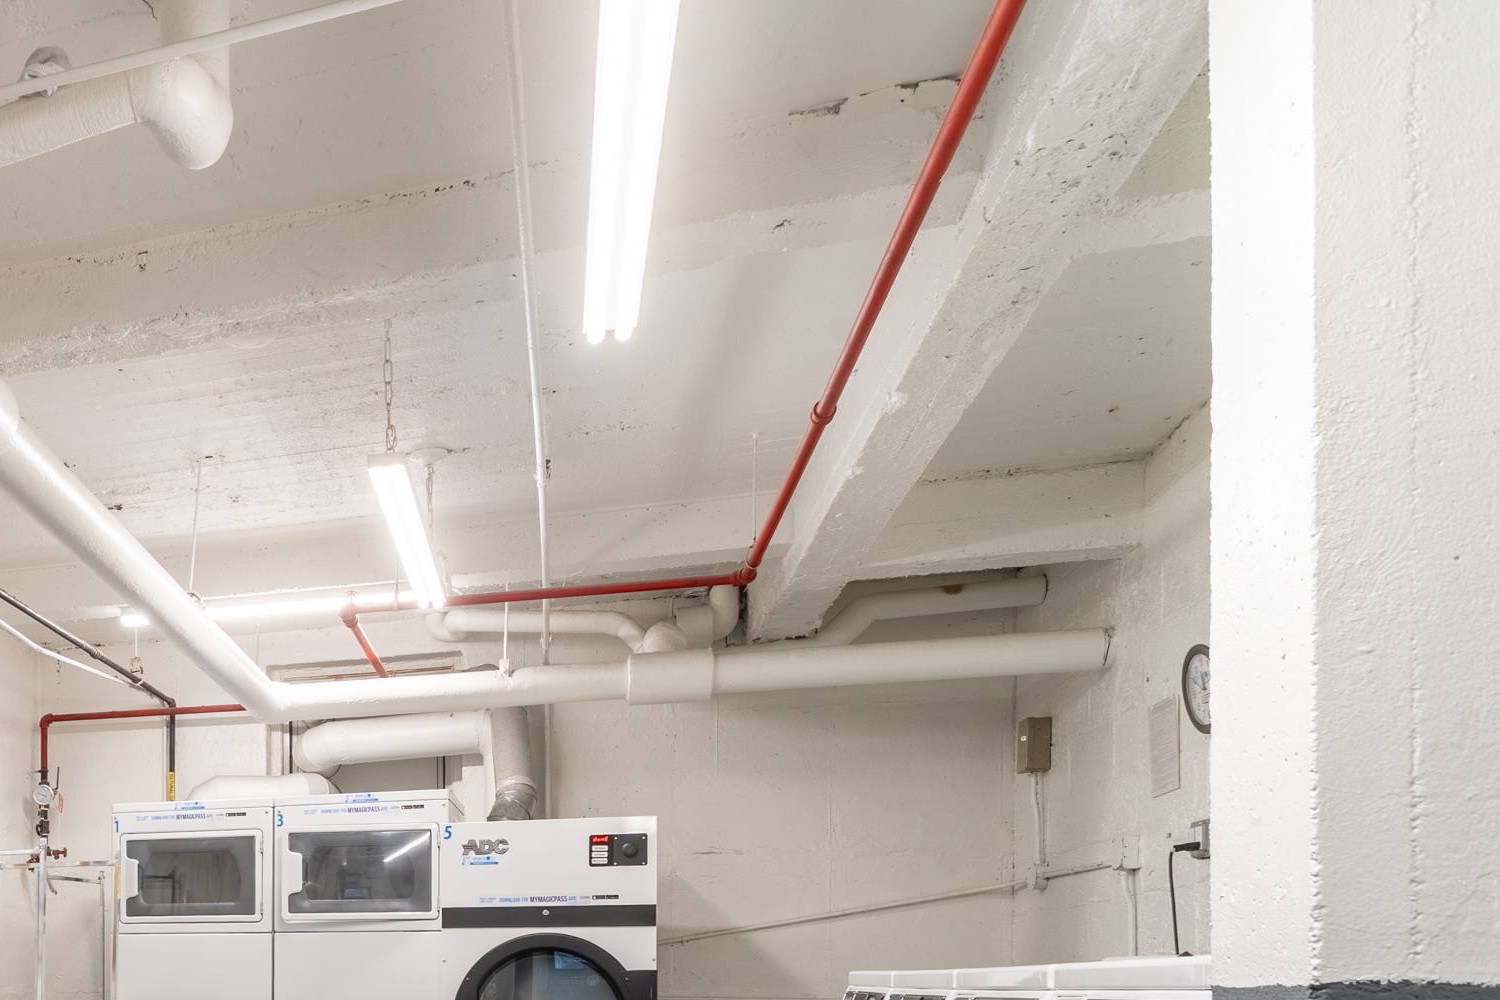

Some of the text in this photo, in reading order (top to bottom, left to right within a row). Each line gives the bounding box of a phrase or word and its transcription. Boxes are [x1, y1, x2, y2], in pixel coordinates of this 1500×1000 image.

[114, 820, 119, 833] 1
[277, 814, 284, 827] 3
[444, 826, 452, 840] 5
[462, 838, 509, 856] ADC
